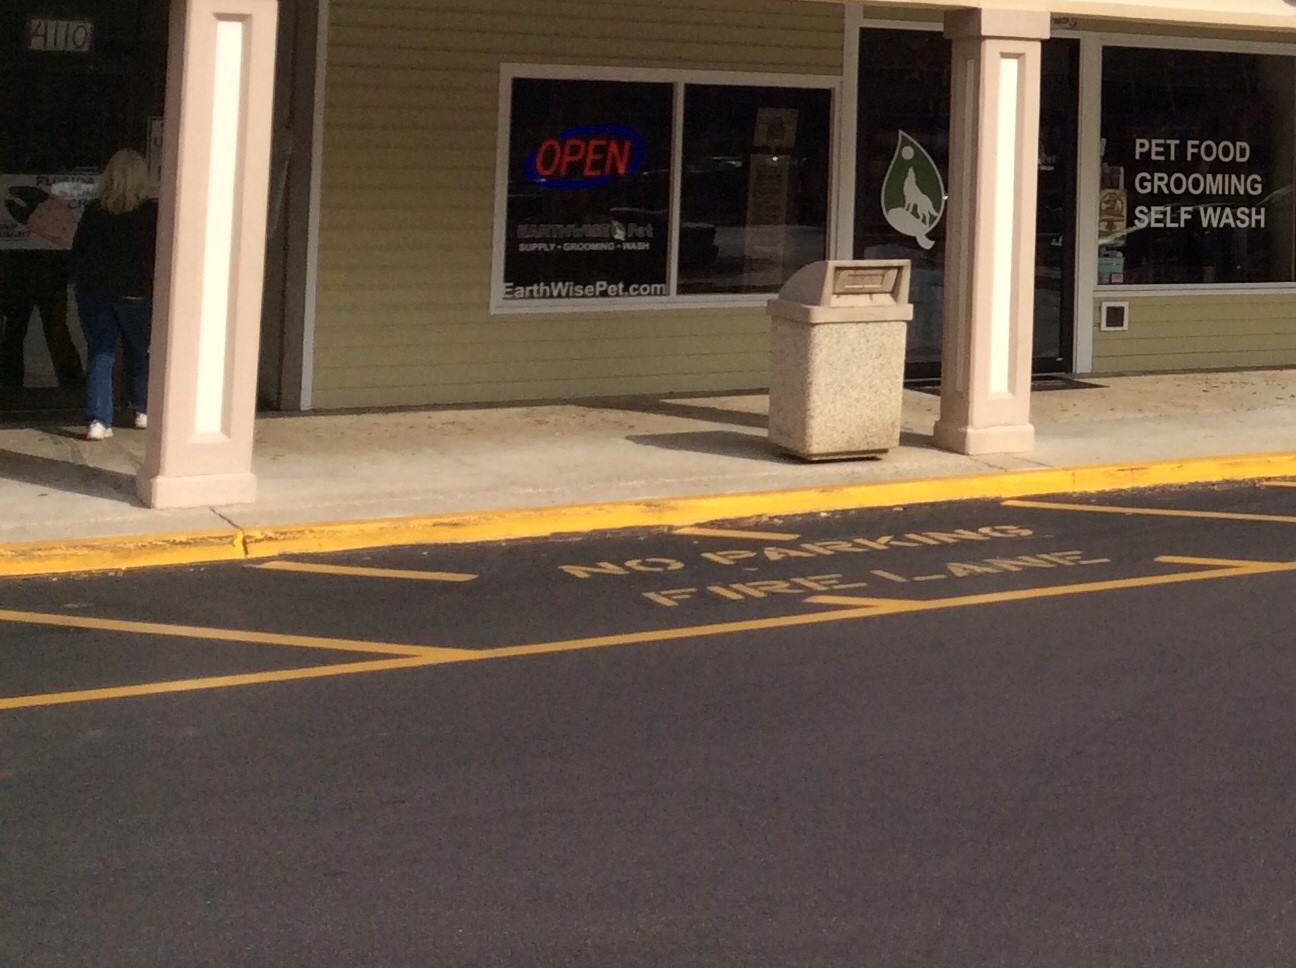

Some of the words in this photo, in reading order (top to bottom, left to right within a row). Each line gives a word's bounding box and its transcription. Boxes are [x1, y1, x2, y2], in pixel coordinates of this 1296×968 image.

[533, 138, 634, 177] OPEN
[1135, 138, 1181, 161] PET
[1186, 139, 1251, 163] FOOD
[1134, 172, 1263, 196] GROOMING
[1134, 205, 1193, 228] SELF
[1200, 206, 1266, 229] WASH
[518, 242, 556, 252] SUPPLY
[563, 242, 615, 251] GROOMING
[622, 241, 650, 250] WASH
[503, 280, 666, 298] EarthWisePet.com
[557, 557, 685, 579] NO
[701, 523, 1034, 567] PARKING
[643, 572, 867, 607] FIRE
[872, 550, 1110, 583] LANE
